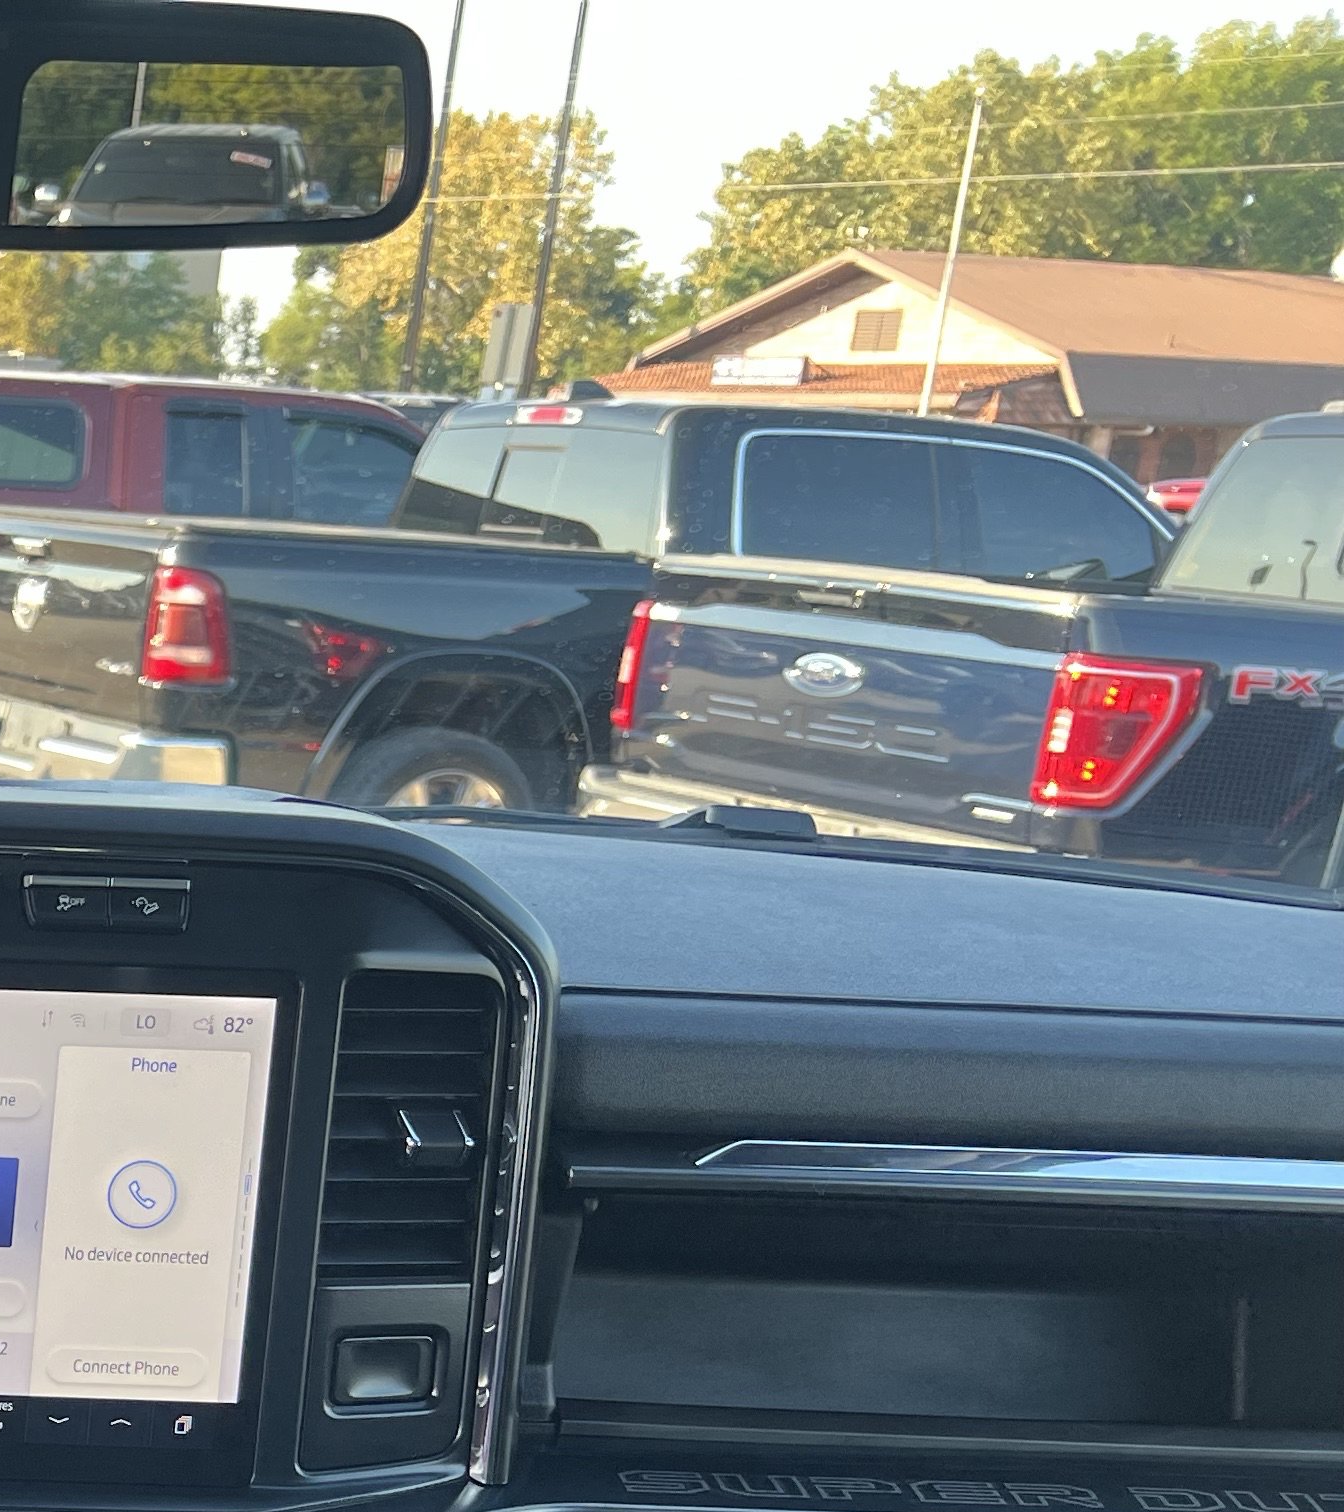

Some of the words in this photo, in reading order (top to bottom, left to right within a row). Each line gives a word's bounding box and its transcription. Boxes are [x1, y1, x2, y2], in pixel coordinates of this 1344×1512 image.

[136, 1014, 156, 1030] LO
[131, 1057, 178, 1074] Phone
[64, 1246, 84, 1261] No
[87, 1247, 132, 1263] device
[134, 1250, 210, 1266] connected
[72, 1359, 132, 1375] Connect
[134, 1361, 180, 1377] Phone
[617, 1469, 1106, 1509] SUPER
